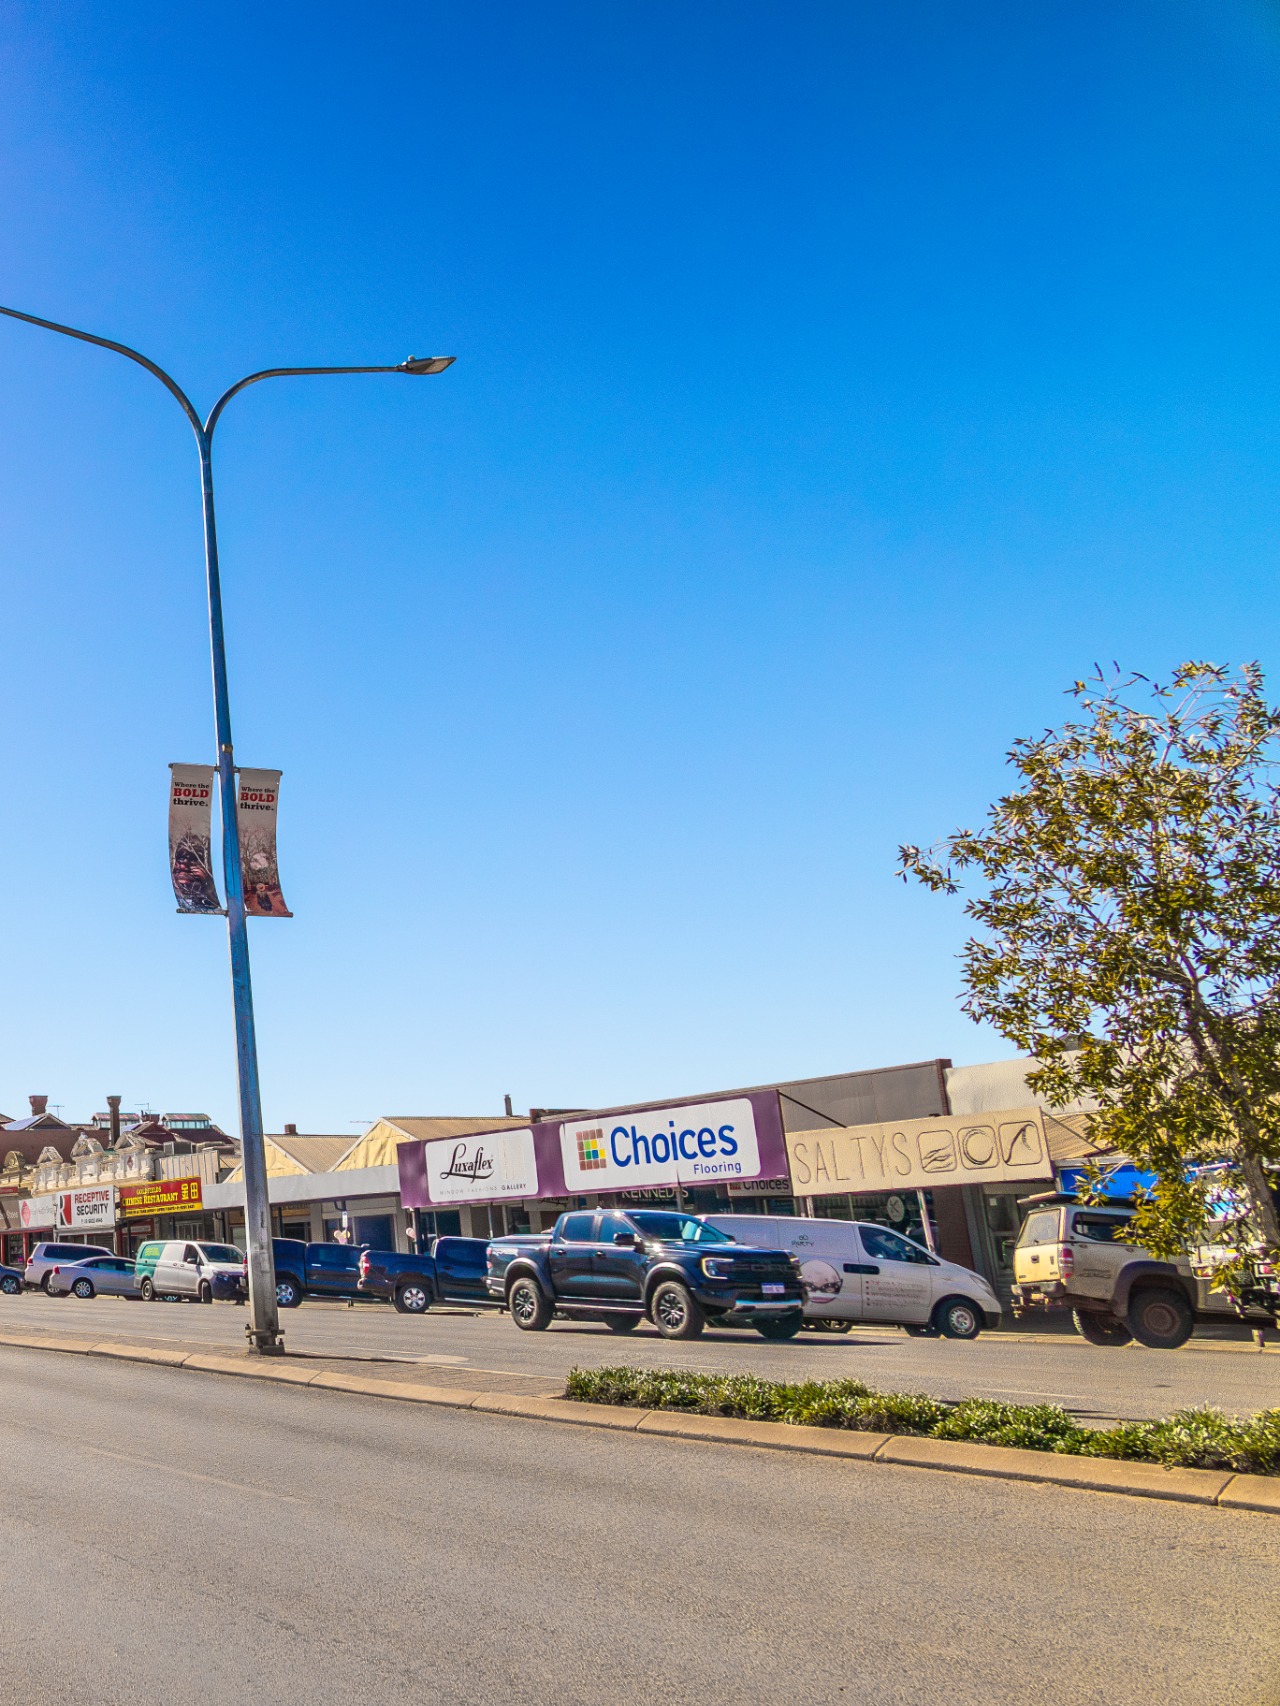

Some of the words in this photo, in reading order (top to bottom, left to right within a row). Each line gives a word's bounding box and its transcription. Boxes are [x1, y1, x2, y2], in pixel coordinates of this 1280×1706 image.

[173, 787, 209, 798] BOLD
[241, 792, 275, 803] BOLD
[173, 798, 209, 807] thrive.
[240, 802, 275, 811] thrive.
[610, 1120, 738, 1167] Choices
[440, 1142, 495, 1184] Luxaflex
[794, 1132, 912, 1185] SALTYS
[693, 1161, 742, 1175] Flooring
[74, 1190, 110, 1204] RECEPTIVE
[143, 1192, 179, 1204] RESTAURANT
[76, 1203, 109, 1216] SECURITY
